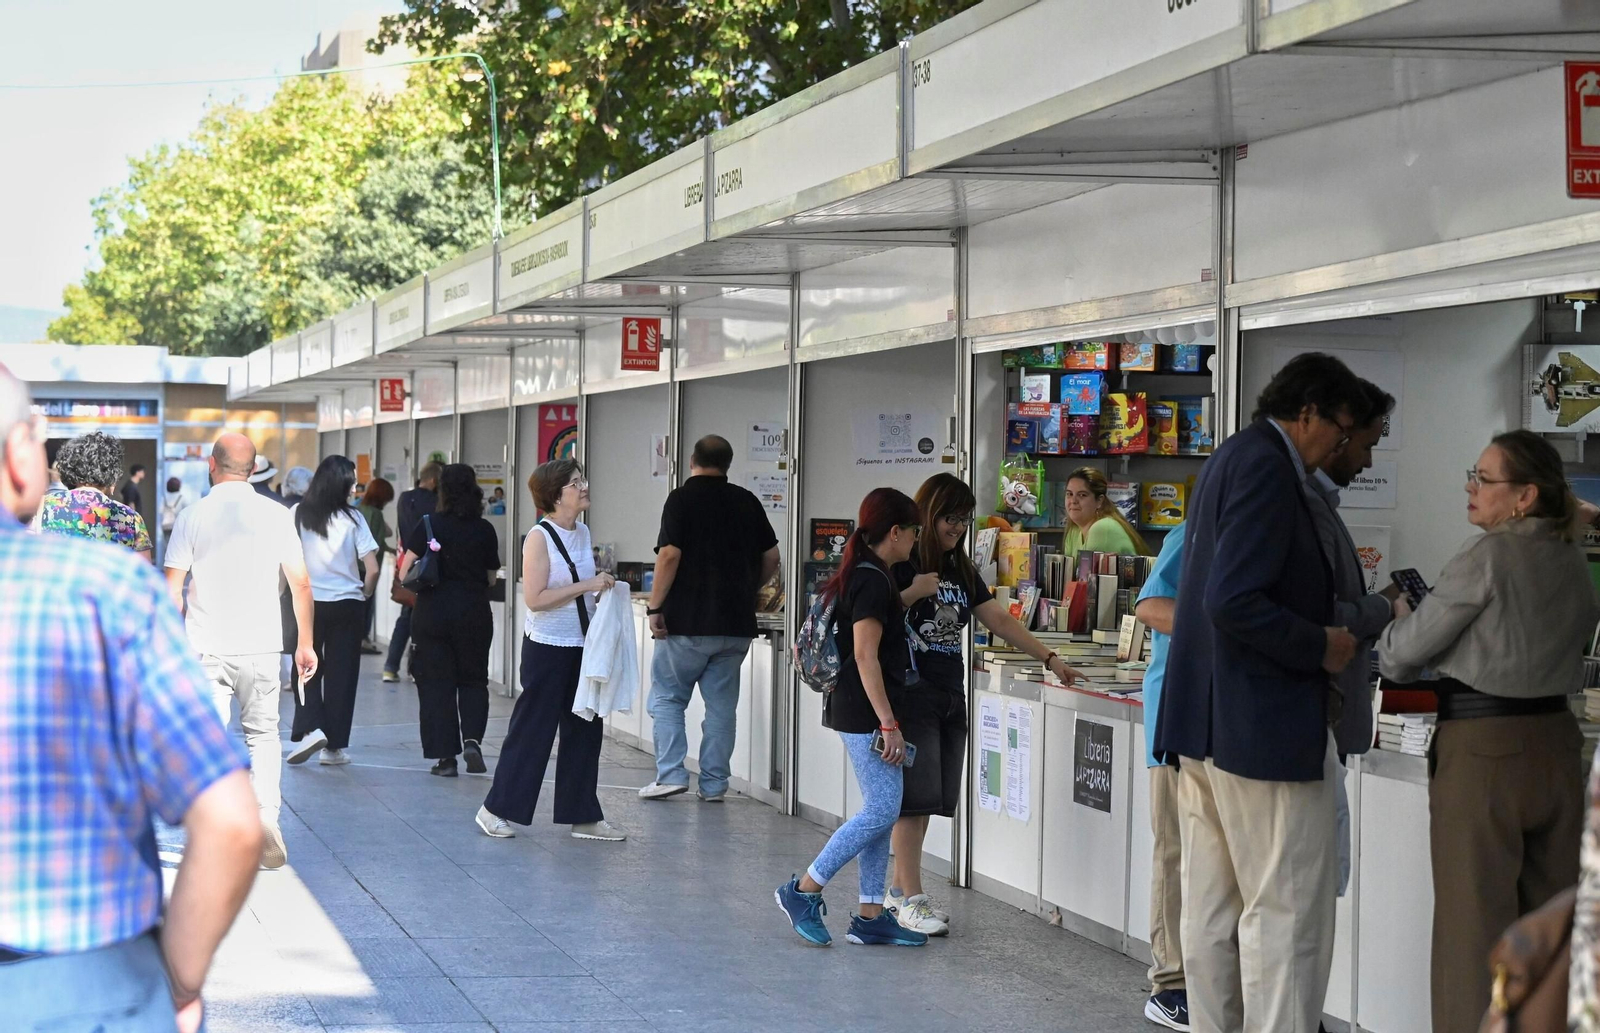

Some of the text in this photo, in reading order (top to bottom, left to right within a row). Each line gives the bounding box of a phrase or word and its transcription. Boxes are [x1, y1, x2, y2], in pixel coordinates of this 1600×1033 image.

[914, 59, 930, 88] 37-38
[545, 407, 577, 420] AL
[816, 527, 848, 536] esqueleto
[937, 588, 968, 607] AMA!
